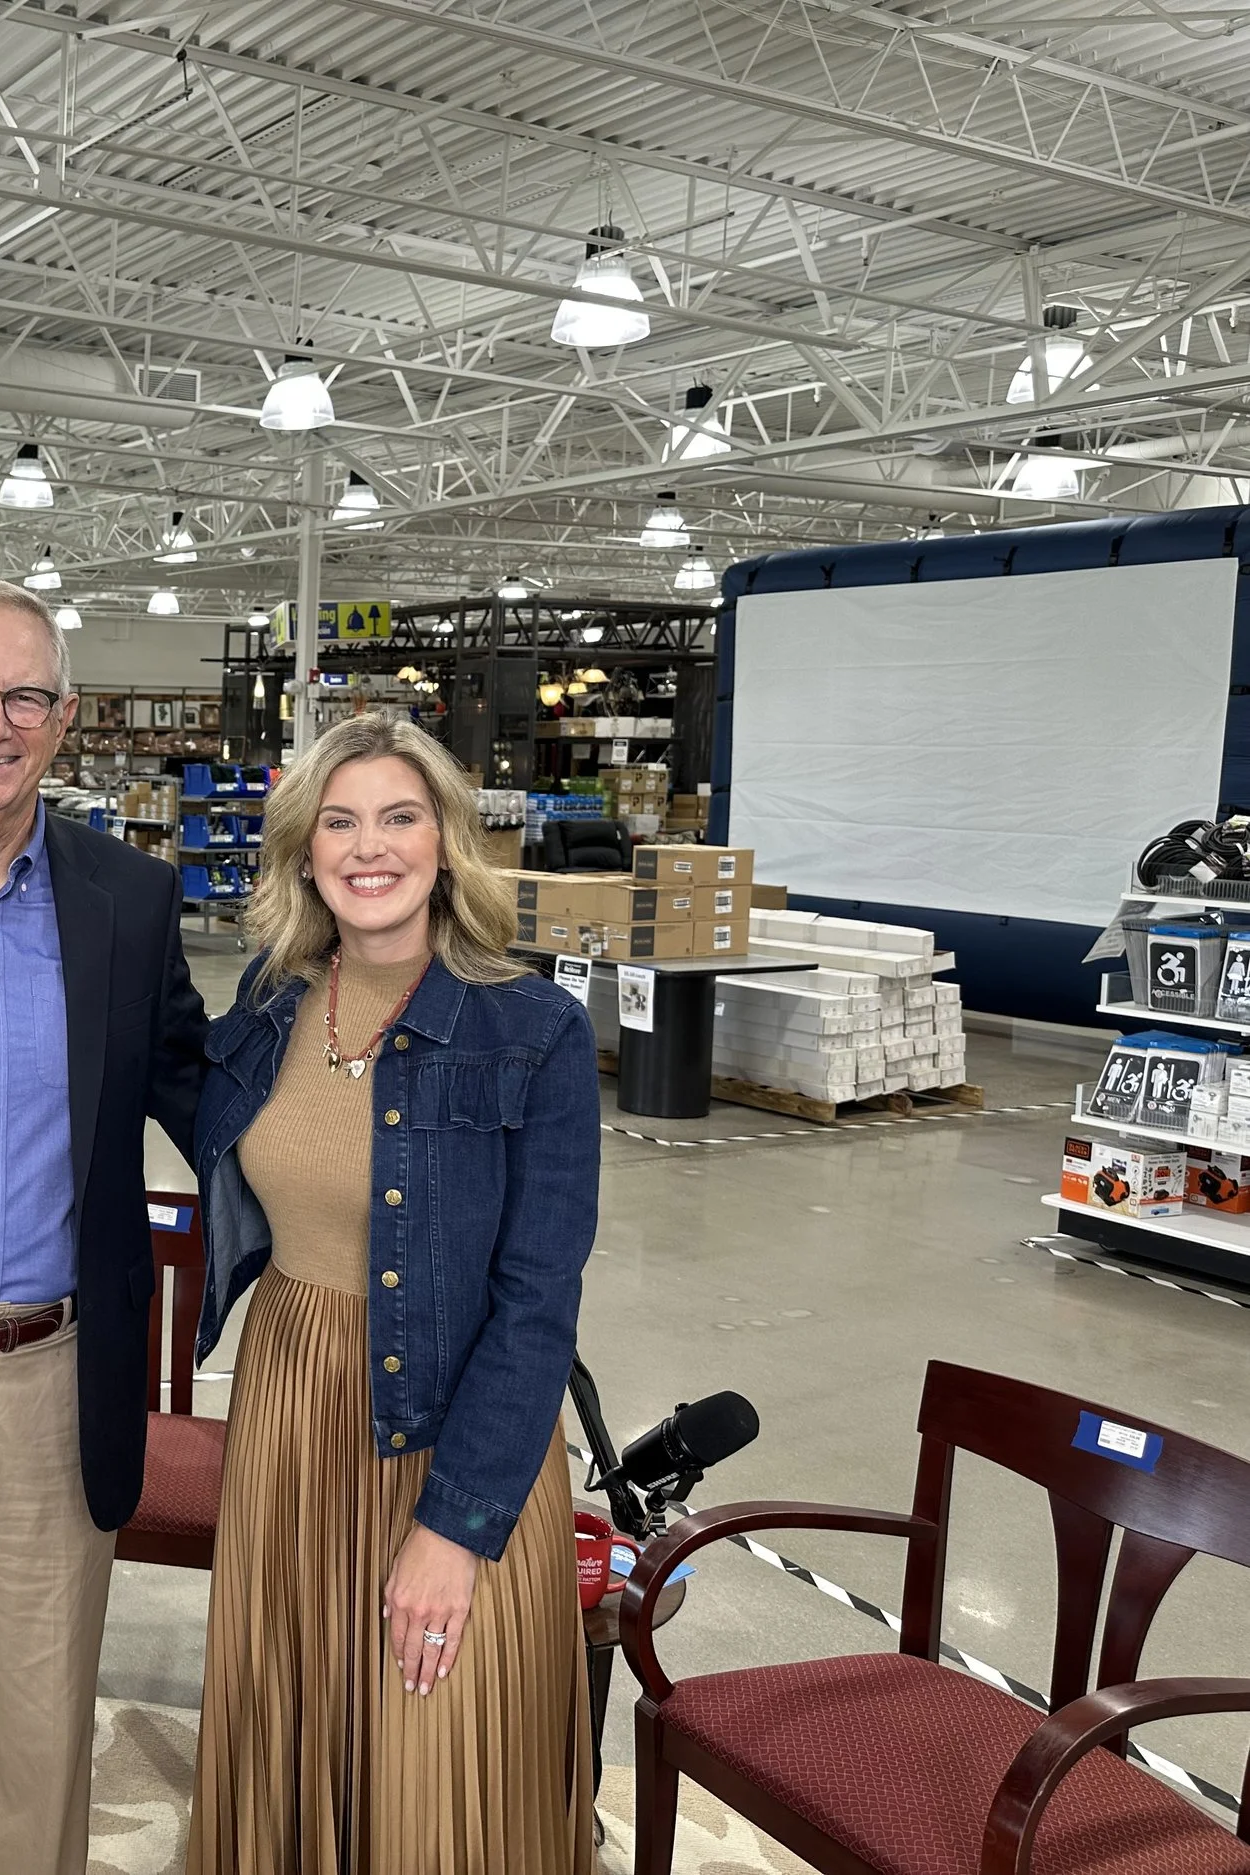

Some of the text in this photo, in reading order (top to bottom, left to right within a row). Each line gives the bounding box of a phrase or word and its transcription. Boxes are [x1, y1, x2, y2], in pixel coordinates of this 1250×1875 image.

[1152, 989, 1195, 1000] ACESSIBLE
[647, 1472, 680, 1489] SHURE
[577, 1567, 602, 1575] UIRED
